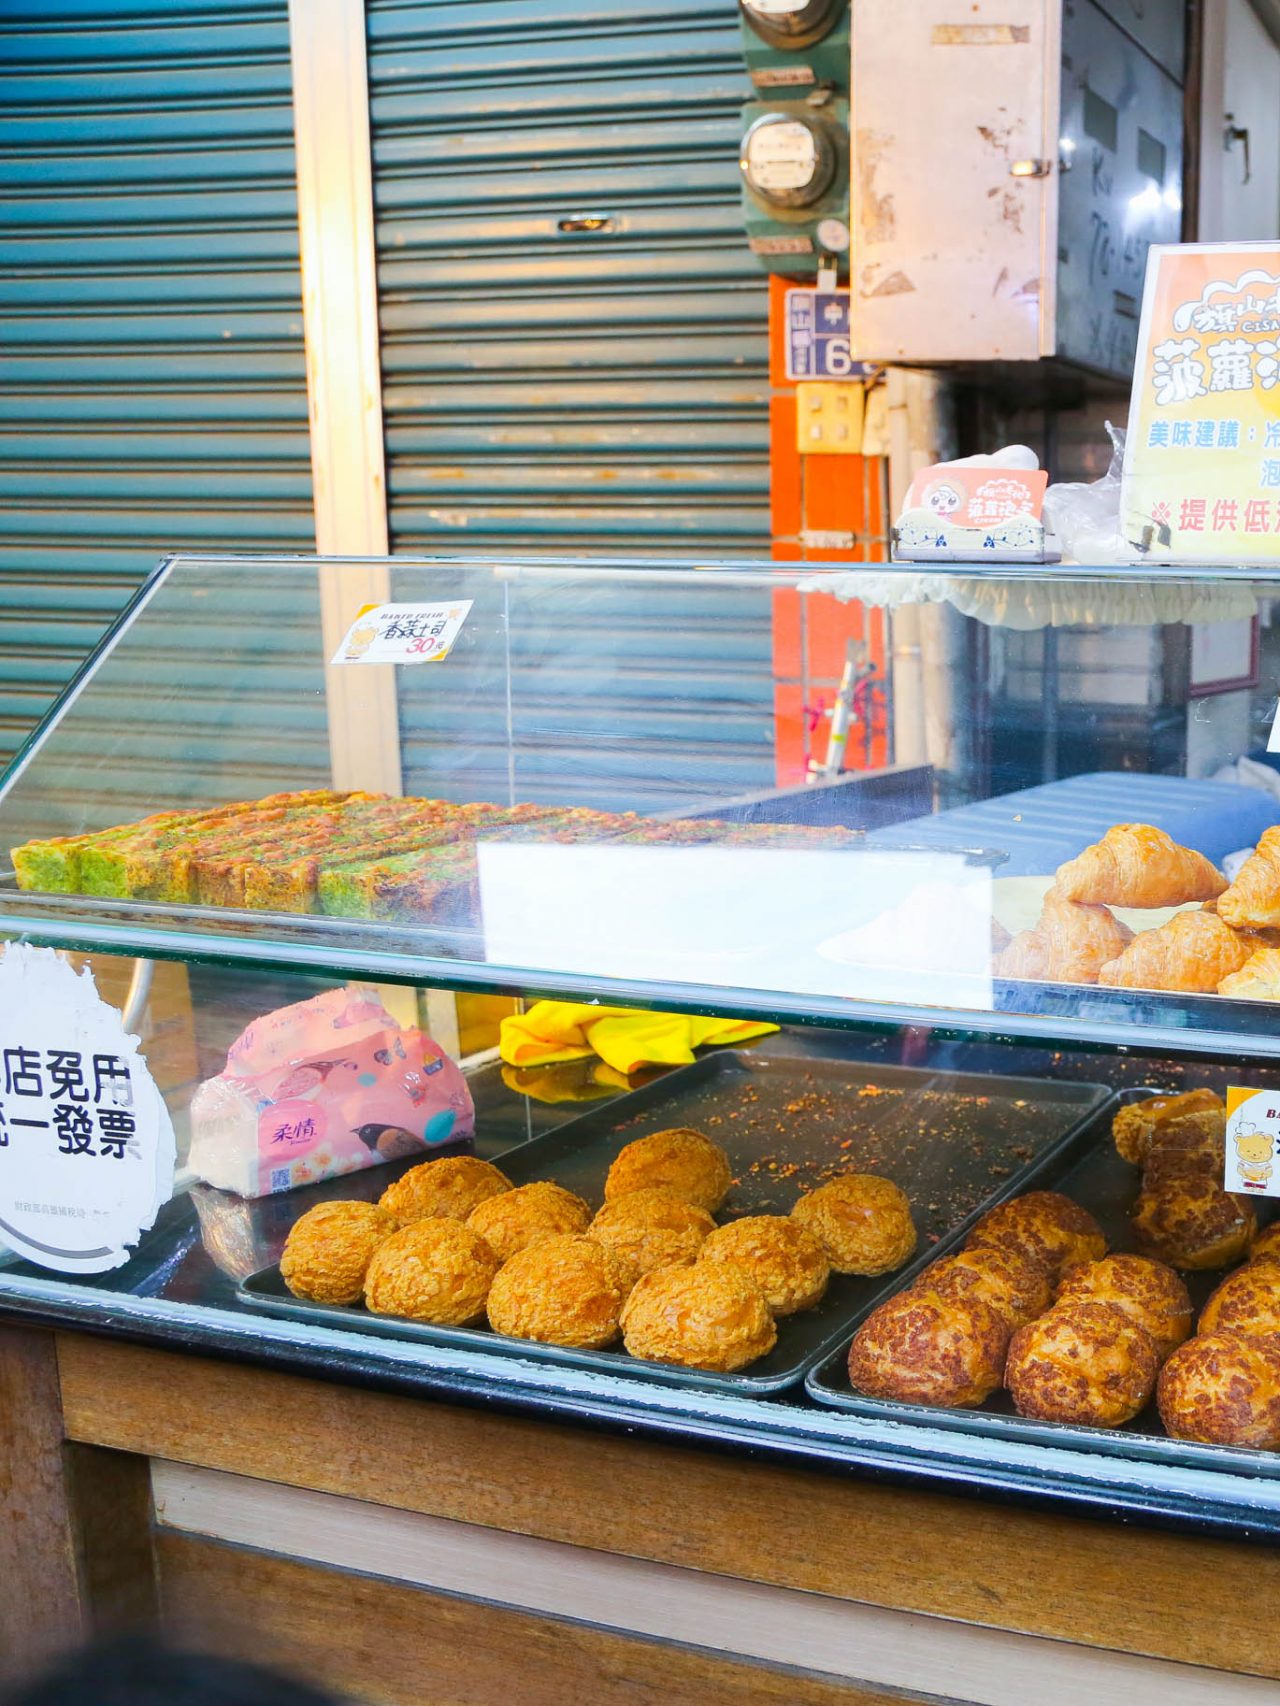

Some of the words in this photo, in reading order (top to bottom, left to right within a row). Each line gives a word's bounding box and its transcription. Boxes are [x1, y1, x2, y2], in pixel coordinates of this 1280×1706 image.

[0, 1045, 133, 1107] 店免用
[270, 1118, 316, 1144] 柔情
